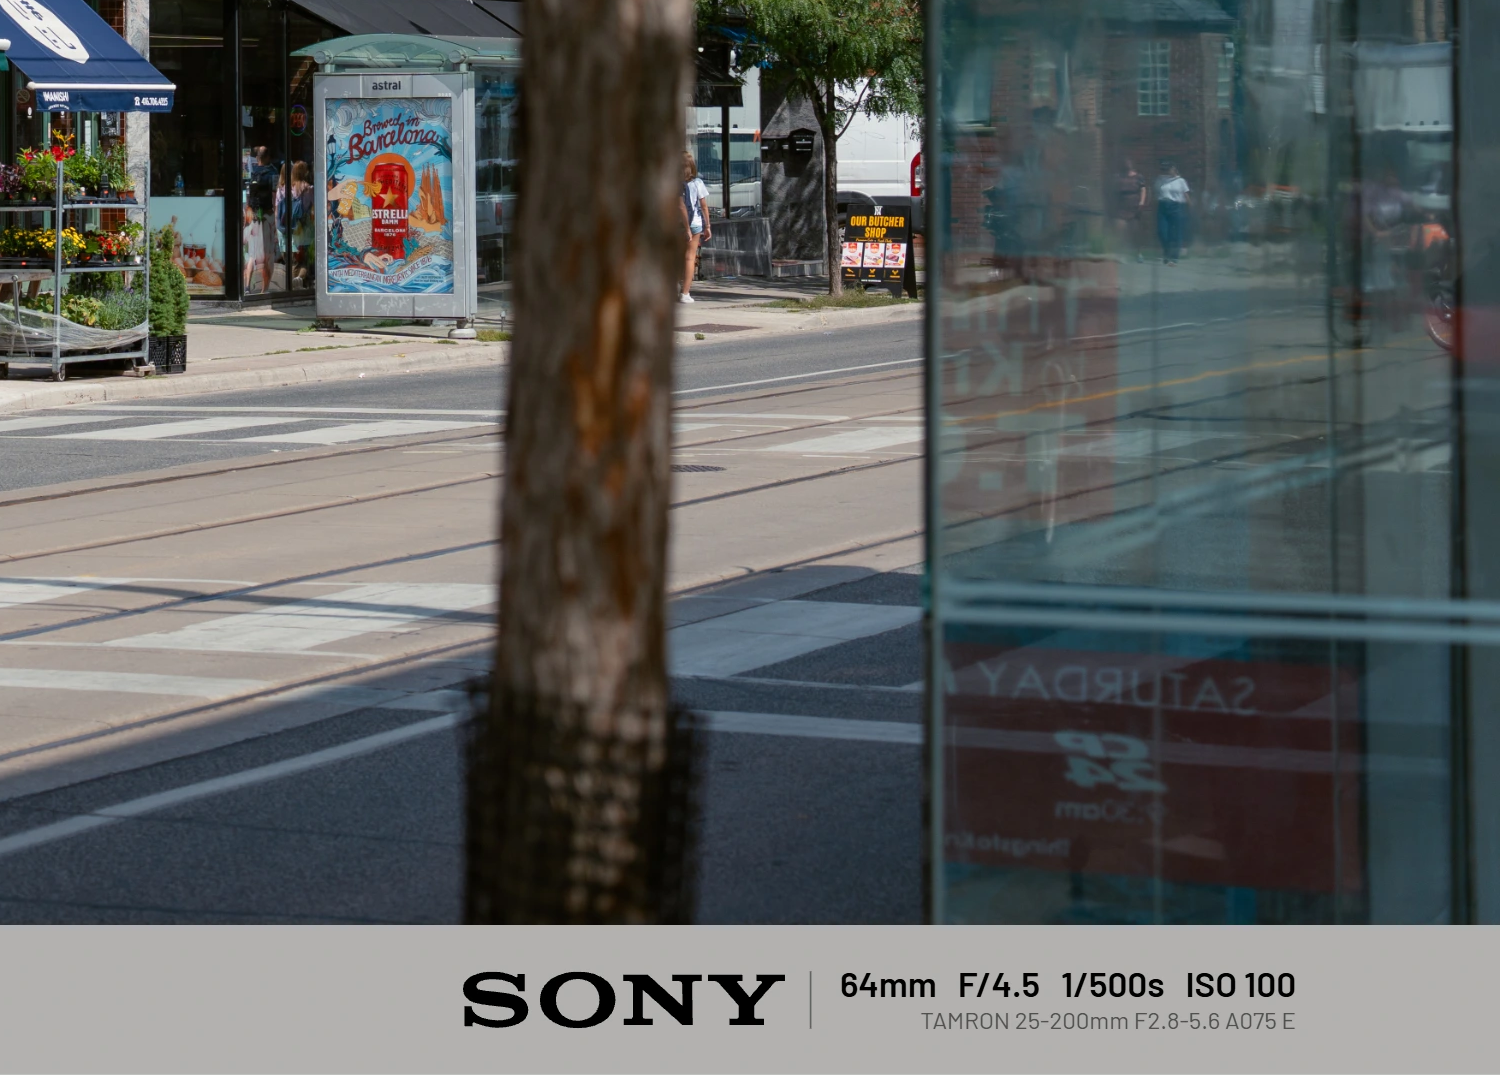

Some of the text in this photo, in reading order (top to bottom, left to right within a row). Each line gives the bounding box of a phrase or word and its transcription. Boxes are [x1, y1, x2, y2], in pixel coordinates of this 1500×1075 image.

[372, 80, 402, 91] astral
[405, 115, 420, 127] in
[346, 122, 440, 165] Barcelona
[850, 216, 905, 228] OUR BUTCHER
[864, 227, 887, 238] SHOP
